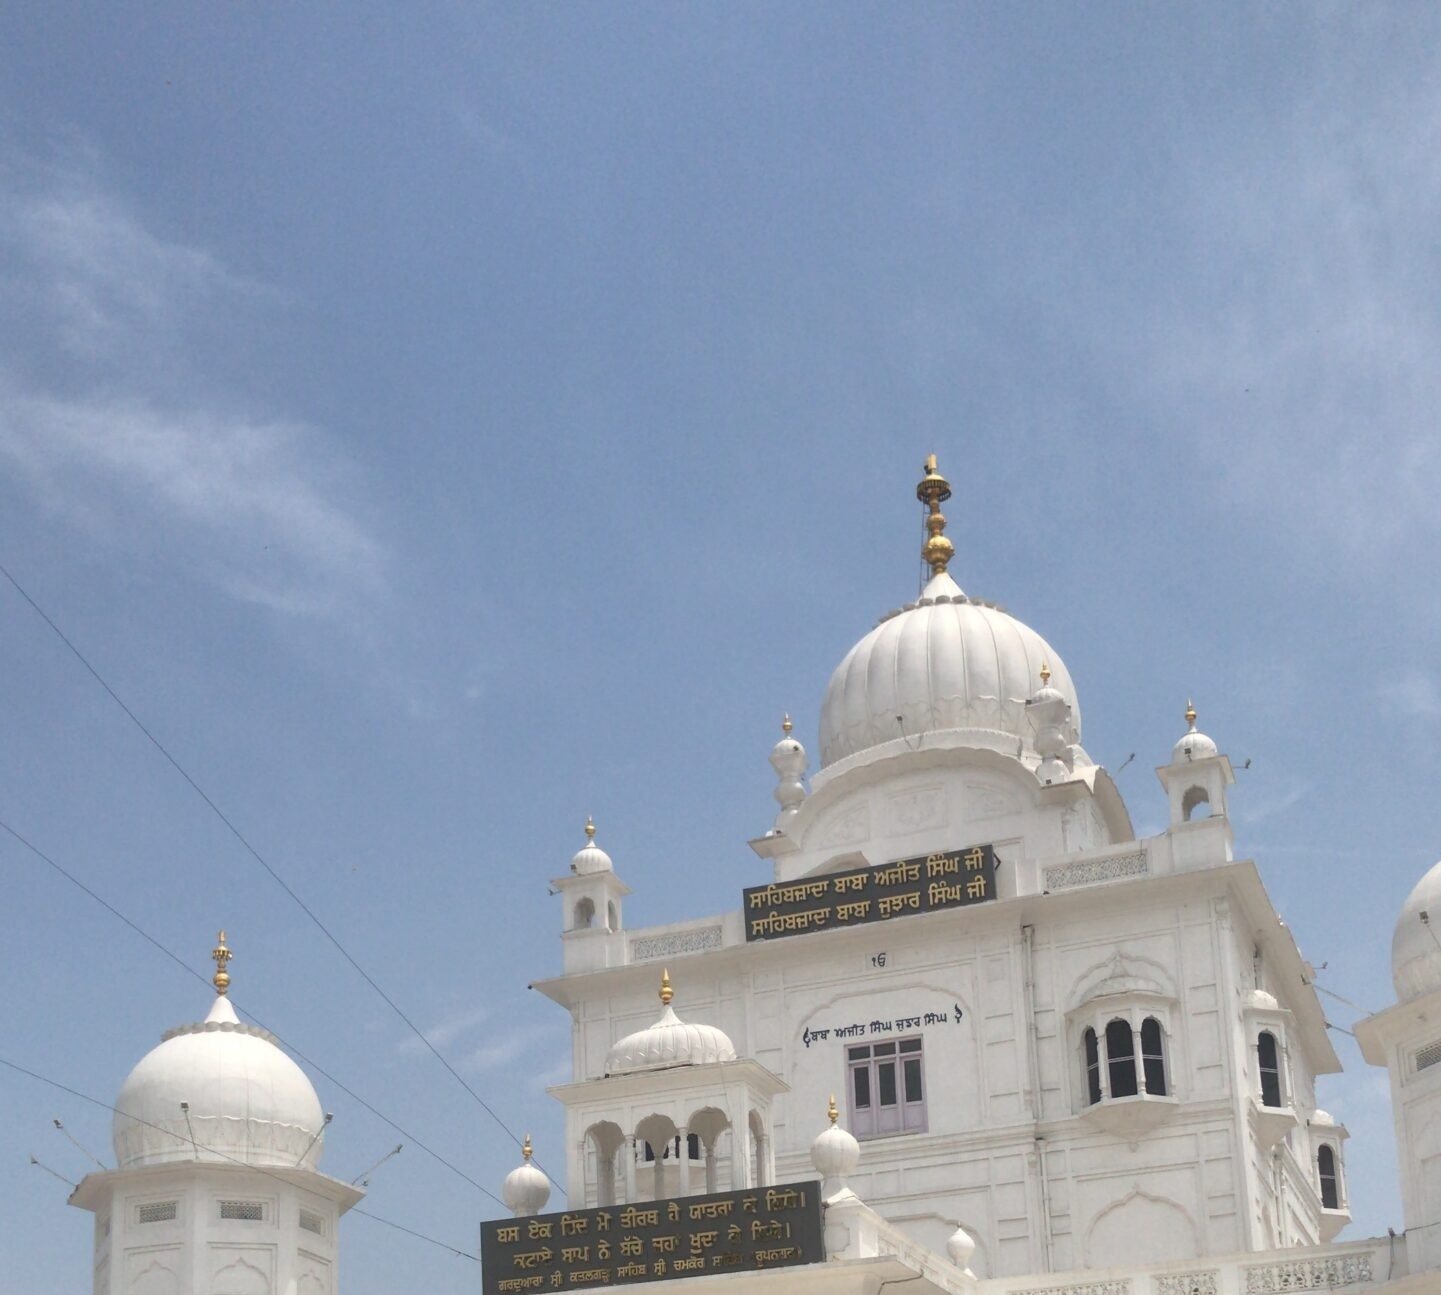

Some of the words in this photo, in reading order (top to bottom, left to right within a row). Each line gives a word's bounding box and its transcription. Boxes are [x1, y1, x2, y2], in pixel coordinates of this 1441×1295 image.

[749, 880, 829, 909] ਸਾਹਿਬਜ਼ਾਦਾ
[834, 873, 869, 894] ਬਾਬਾ
[873, 860, 921, 886] ਅਜੀਤ
[926, 853, 960, 878] ਸਿੰਘ
[964, 847, 985, 871] ਜੀ
[751, 907, 831, 936] ਸਾਹਿਬਜ਼ਾਦਾ
[836, 900, 872, 921] ਬਾਬਾ
[878, 891, 921, 919] ਜੁਝਾਰ
[928, 880, 961, 906] ਸਿੰਘ
[966, 875, 987, 900] ਜੀ
[810, 1029, 830, 1042] ਬਾਬਾ
[834, 1024, 867, 1038] ਅਜੀਤ
[869, 1019, 892, 1034] ਸਿੰਘ
[895, 1016, 920, 1032] ਜੁਝਾਰ
[924, 1012, 948, 1026] ਸਿੰਘ
[496, 1225, 520, 1243] ਬਸ
[528, 1219, 553, 1239] ਏਕ
[667, 1201, 681, 1222] ਹੈ
[598, 1239, 612, 1260] ਨੇ
[620, 1235, 645, 1257] ਬੱਚੇ
[617, 1261, 647, 1278] ਸਾਹਿਬ
